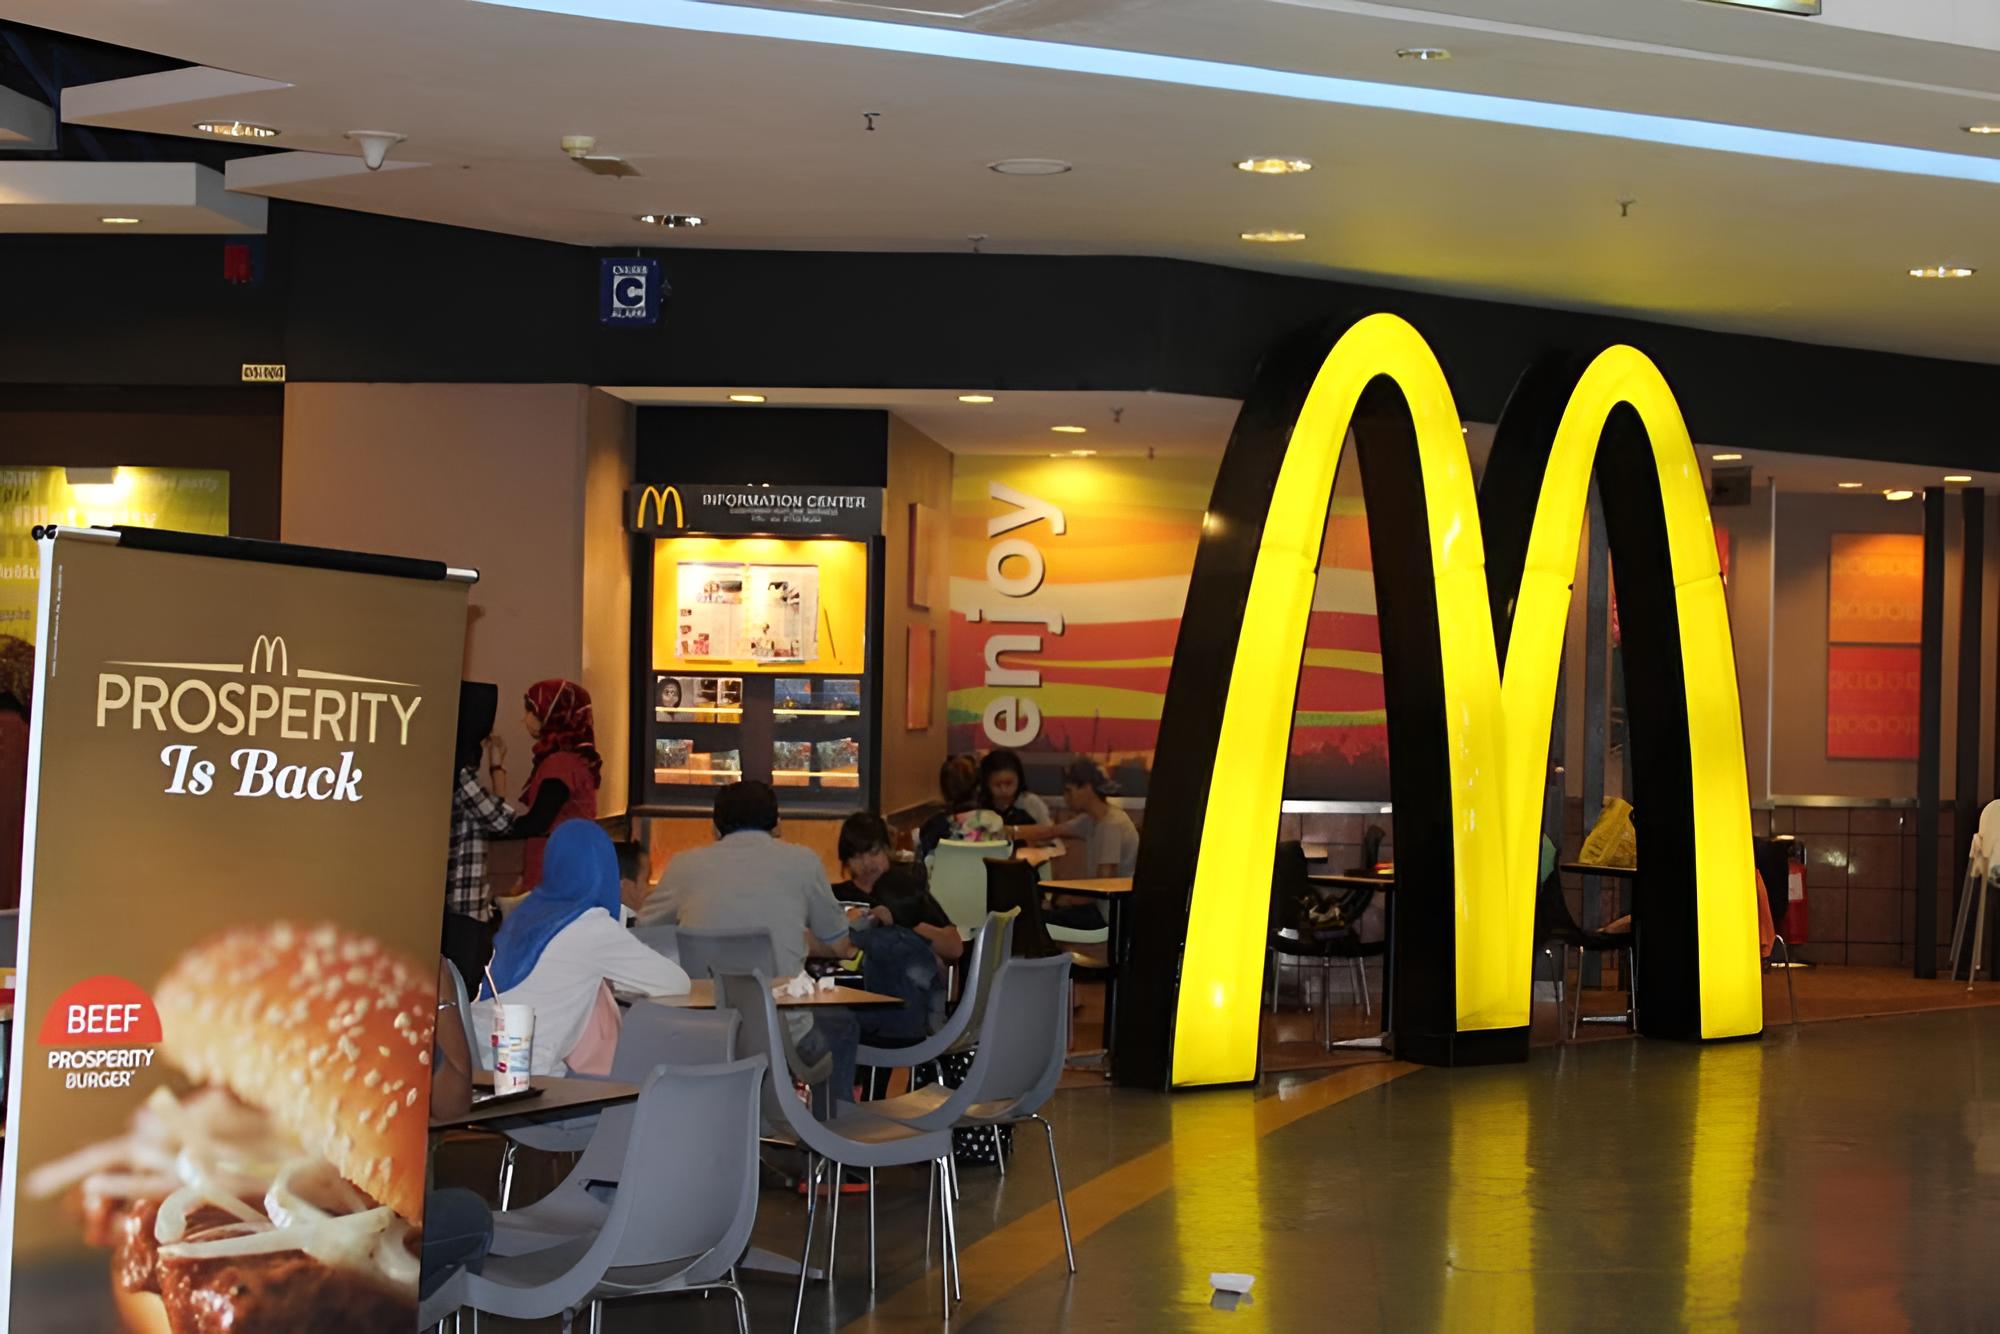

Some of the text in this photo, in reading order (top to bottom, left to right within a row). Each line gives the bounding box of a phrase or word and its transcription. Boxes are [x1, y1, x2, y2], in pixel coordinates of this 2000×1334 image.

[615, 277, 644, 307] C
[965, 480, 1066, 748] enjoy
[96, 673, 423, 745] PROSPERITY
[160, 745, 364, 802] Is Back
[67, 1003, 142, 1034] BEEF
[48, 1049, 155, 1069] PROSPERITY
